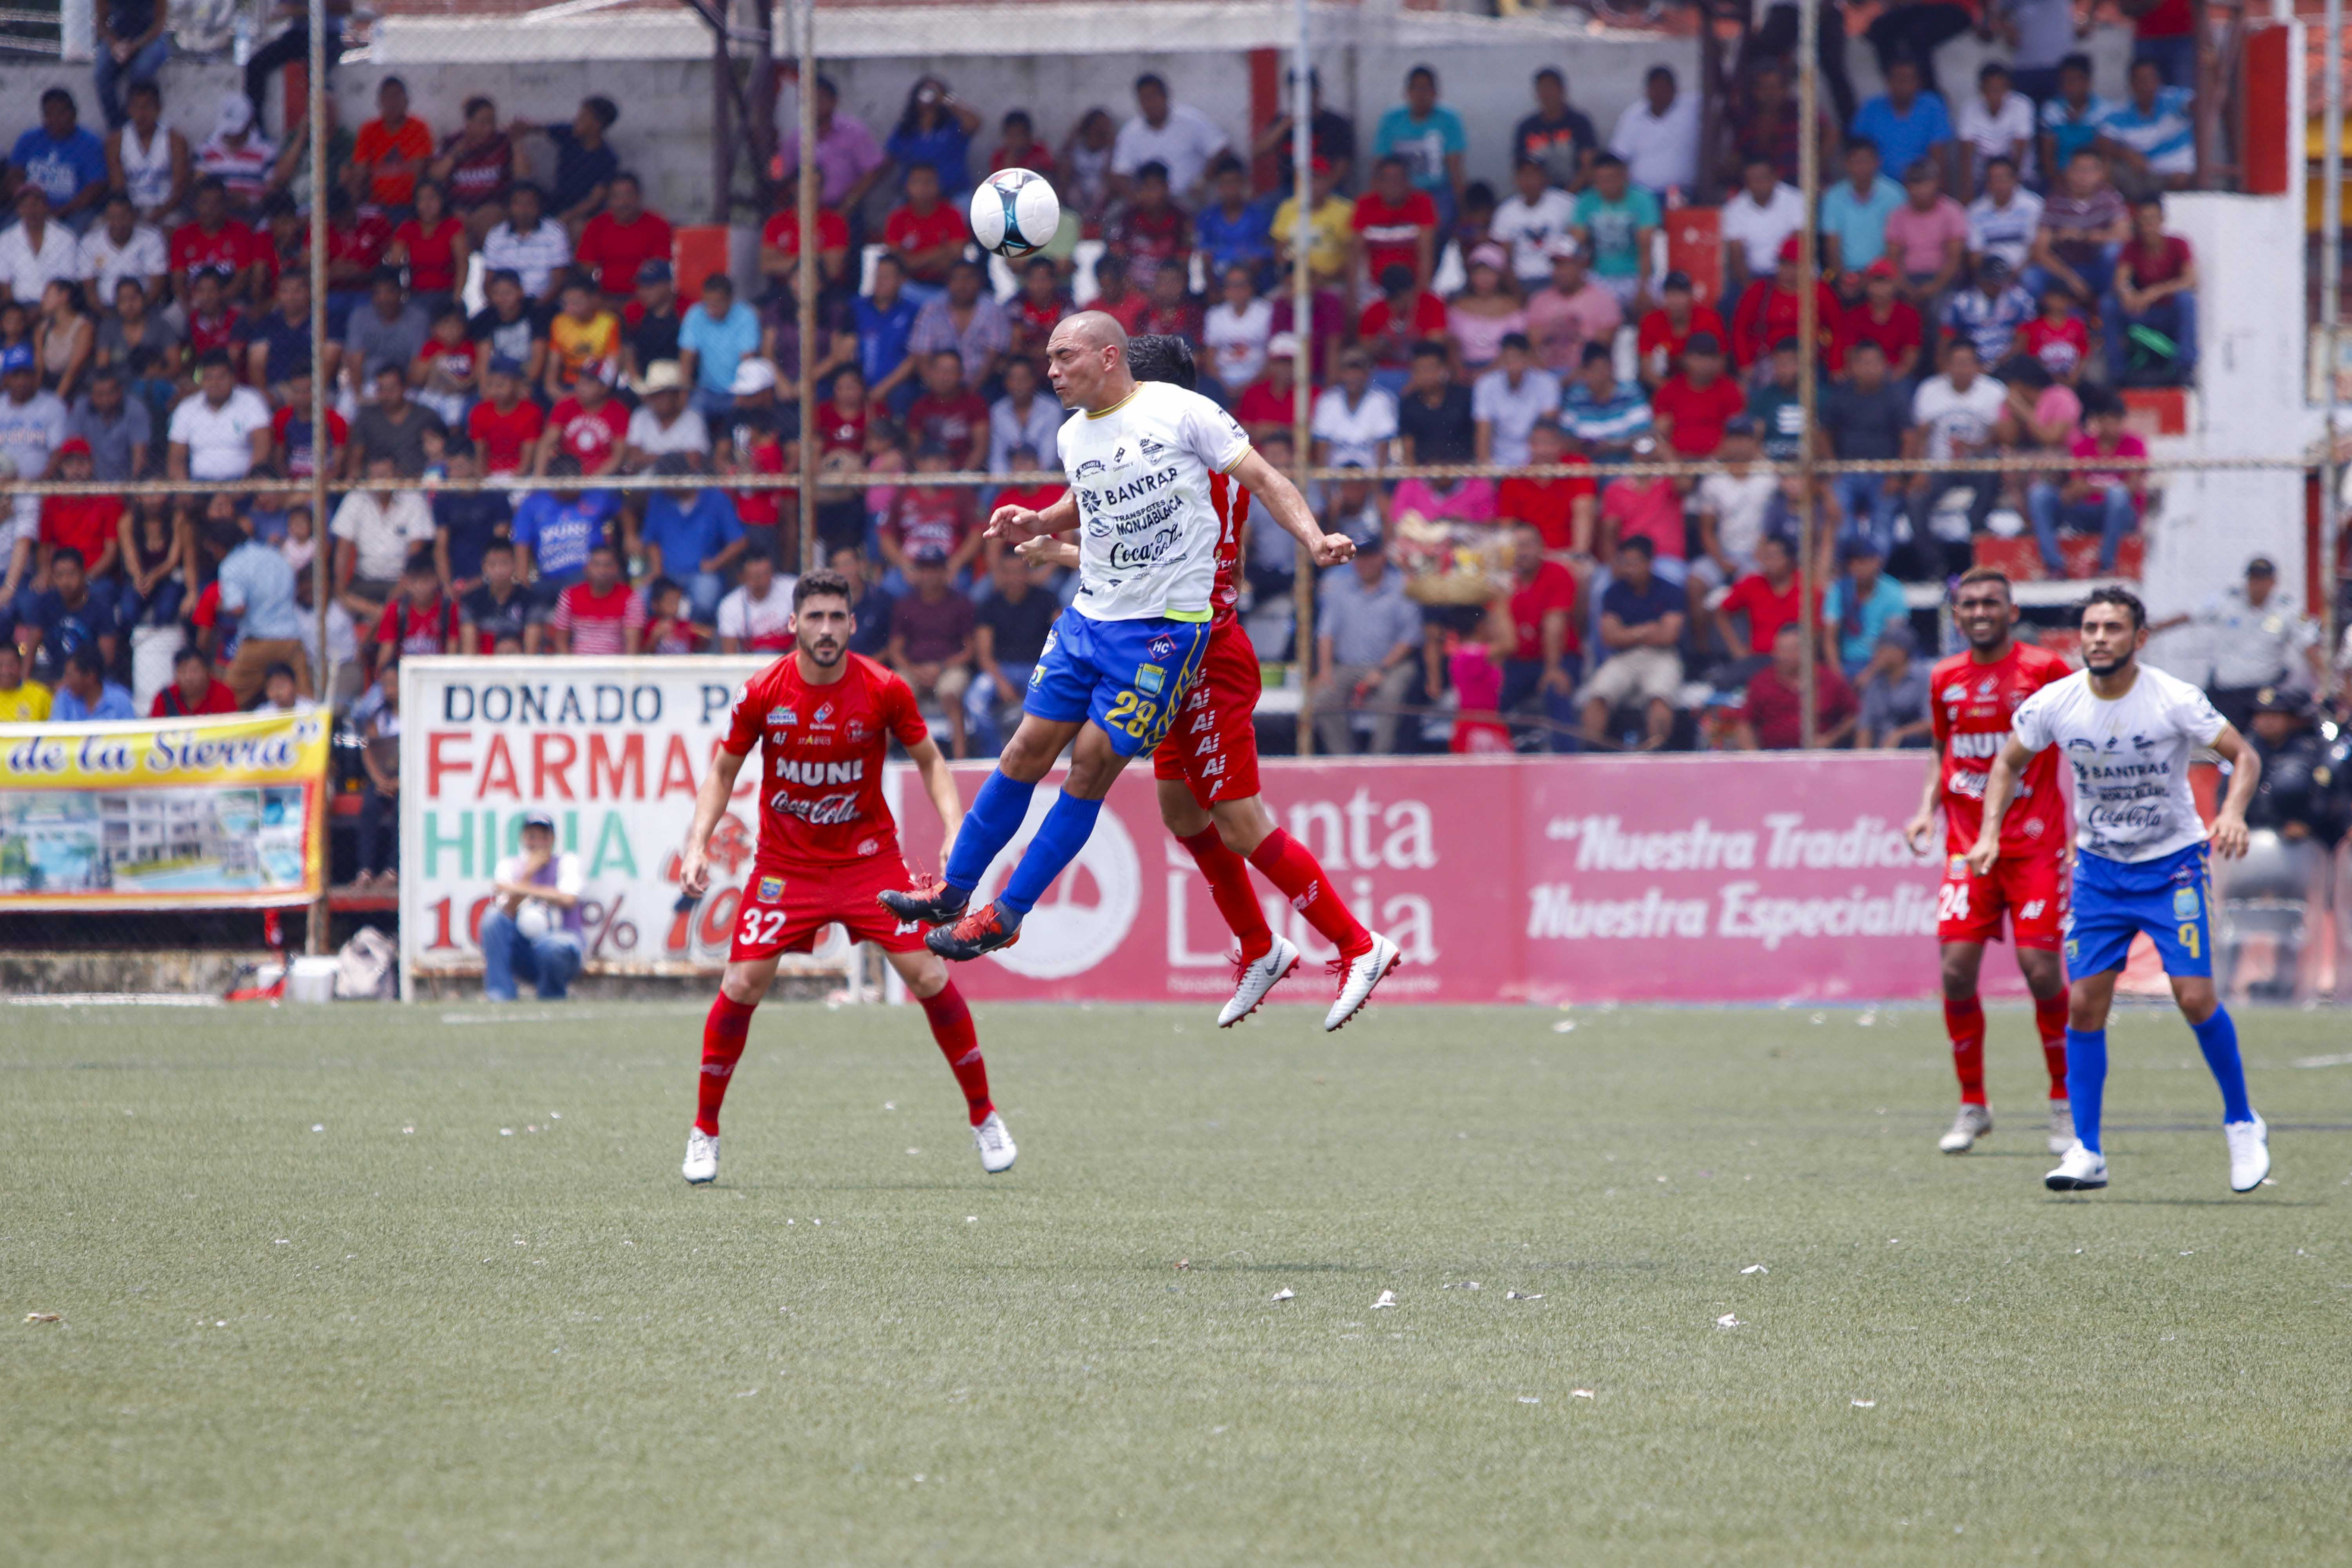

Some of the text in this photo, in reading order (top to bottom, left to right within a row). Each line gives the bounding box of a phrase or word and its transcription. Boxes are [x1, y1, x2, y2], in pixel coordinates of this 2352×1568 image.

[1114, 499, 1166, 521] TRANSPOTES
[1152, 641, 1169, 654] HC
[443, 684, 662, 723] DONADO
[1104, 691, 1157, 738] 28
[9, 736, 64, 771] de
[78, 735, 133, 770] la
[776, 756, 863, 786] MUNI
[1527, 882, 1708, 938] Nuestra
[1938, 883, 1970, 921] 24
[739, 907, 787, 945] 32
[2178, 922, 2201, 959] 9
